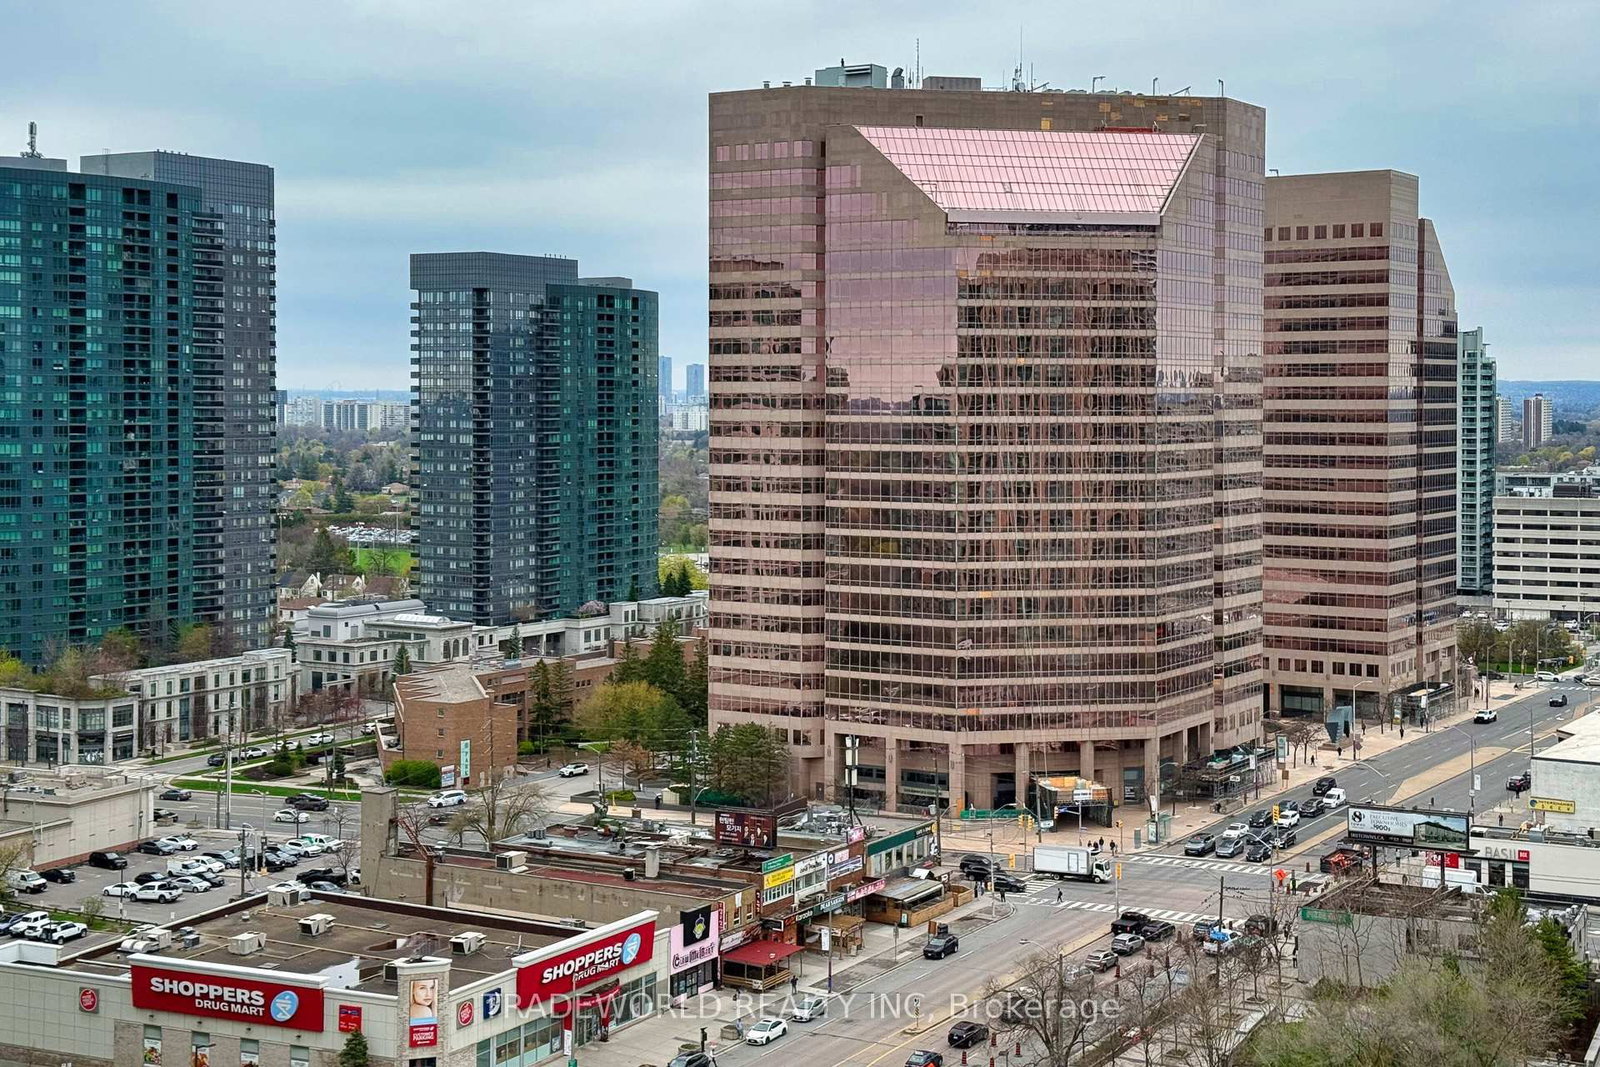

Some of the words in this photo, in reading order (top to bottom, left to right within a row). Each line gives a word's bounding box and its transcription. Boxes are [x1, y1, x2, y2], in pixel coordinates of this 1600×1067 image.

[541, 941, 623, 984] SHOPPERS
[573, 966, 599, 982] DRUG
[596, 958, 620, 974] MART
[150, 977, 265, 1007] SHOPPERS
[195, 998, 229, 1013] DRUG
[230, 1002, 265, 1017] MART
